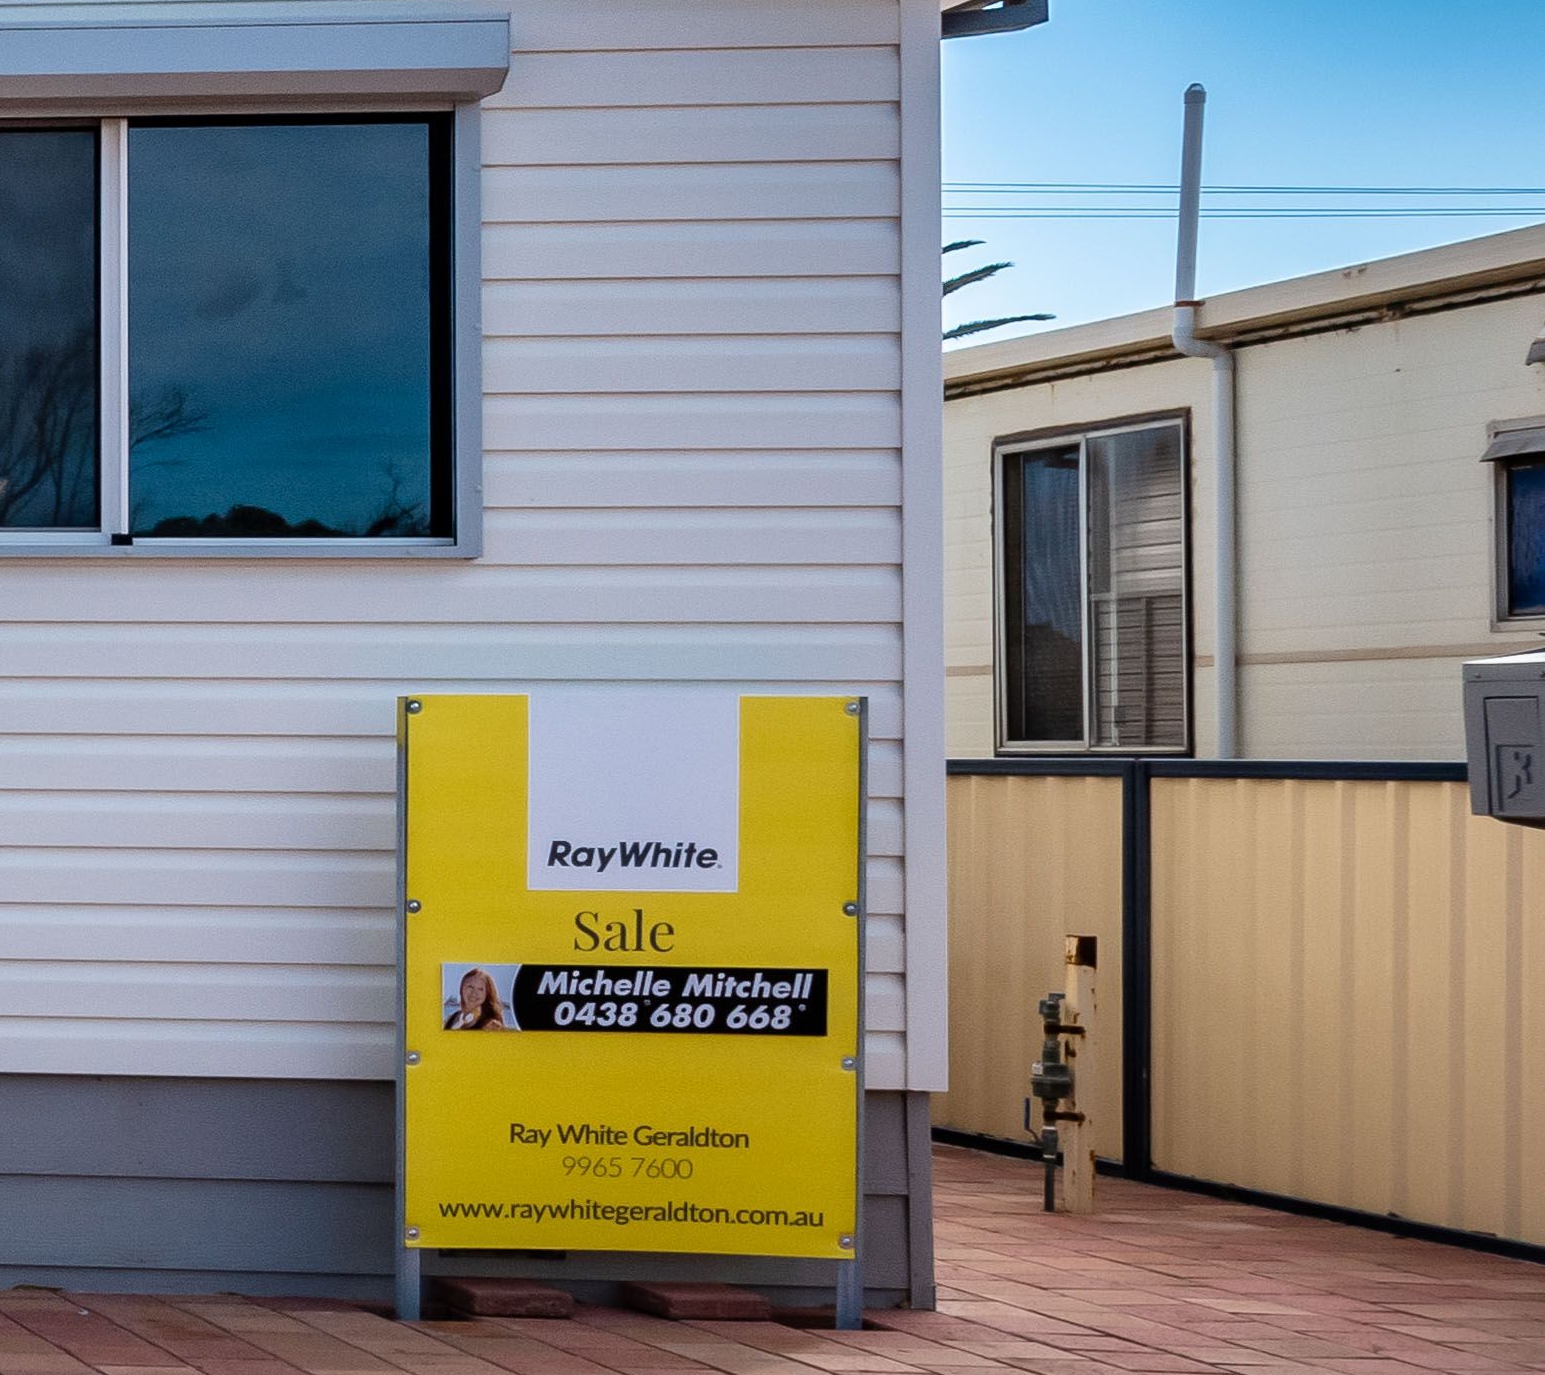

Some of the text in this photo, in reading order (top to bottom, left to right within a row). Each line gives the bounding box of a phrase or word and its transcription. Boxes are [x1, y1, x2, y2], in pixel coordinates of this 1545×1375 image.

[573, 908, 675, 953] Sale
[537, 970, 814, 1000] Michelle Mitchell
[554, 1001, 793, 1030] 0438 680 668
[510, 1123, 751, 1149] Ray White Geraldton
[562, 1155, 694, 1180] 9965 7600
[439, 1198, 825, 1227] www.raywhitegeraldton.com.au
